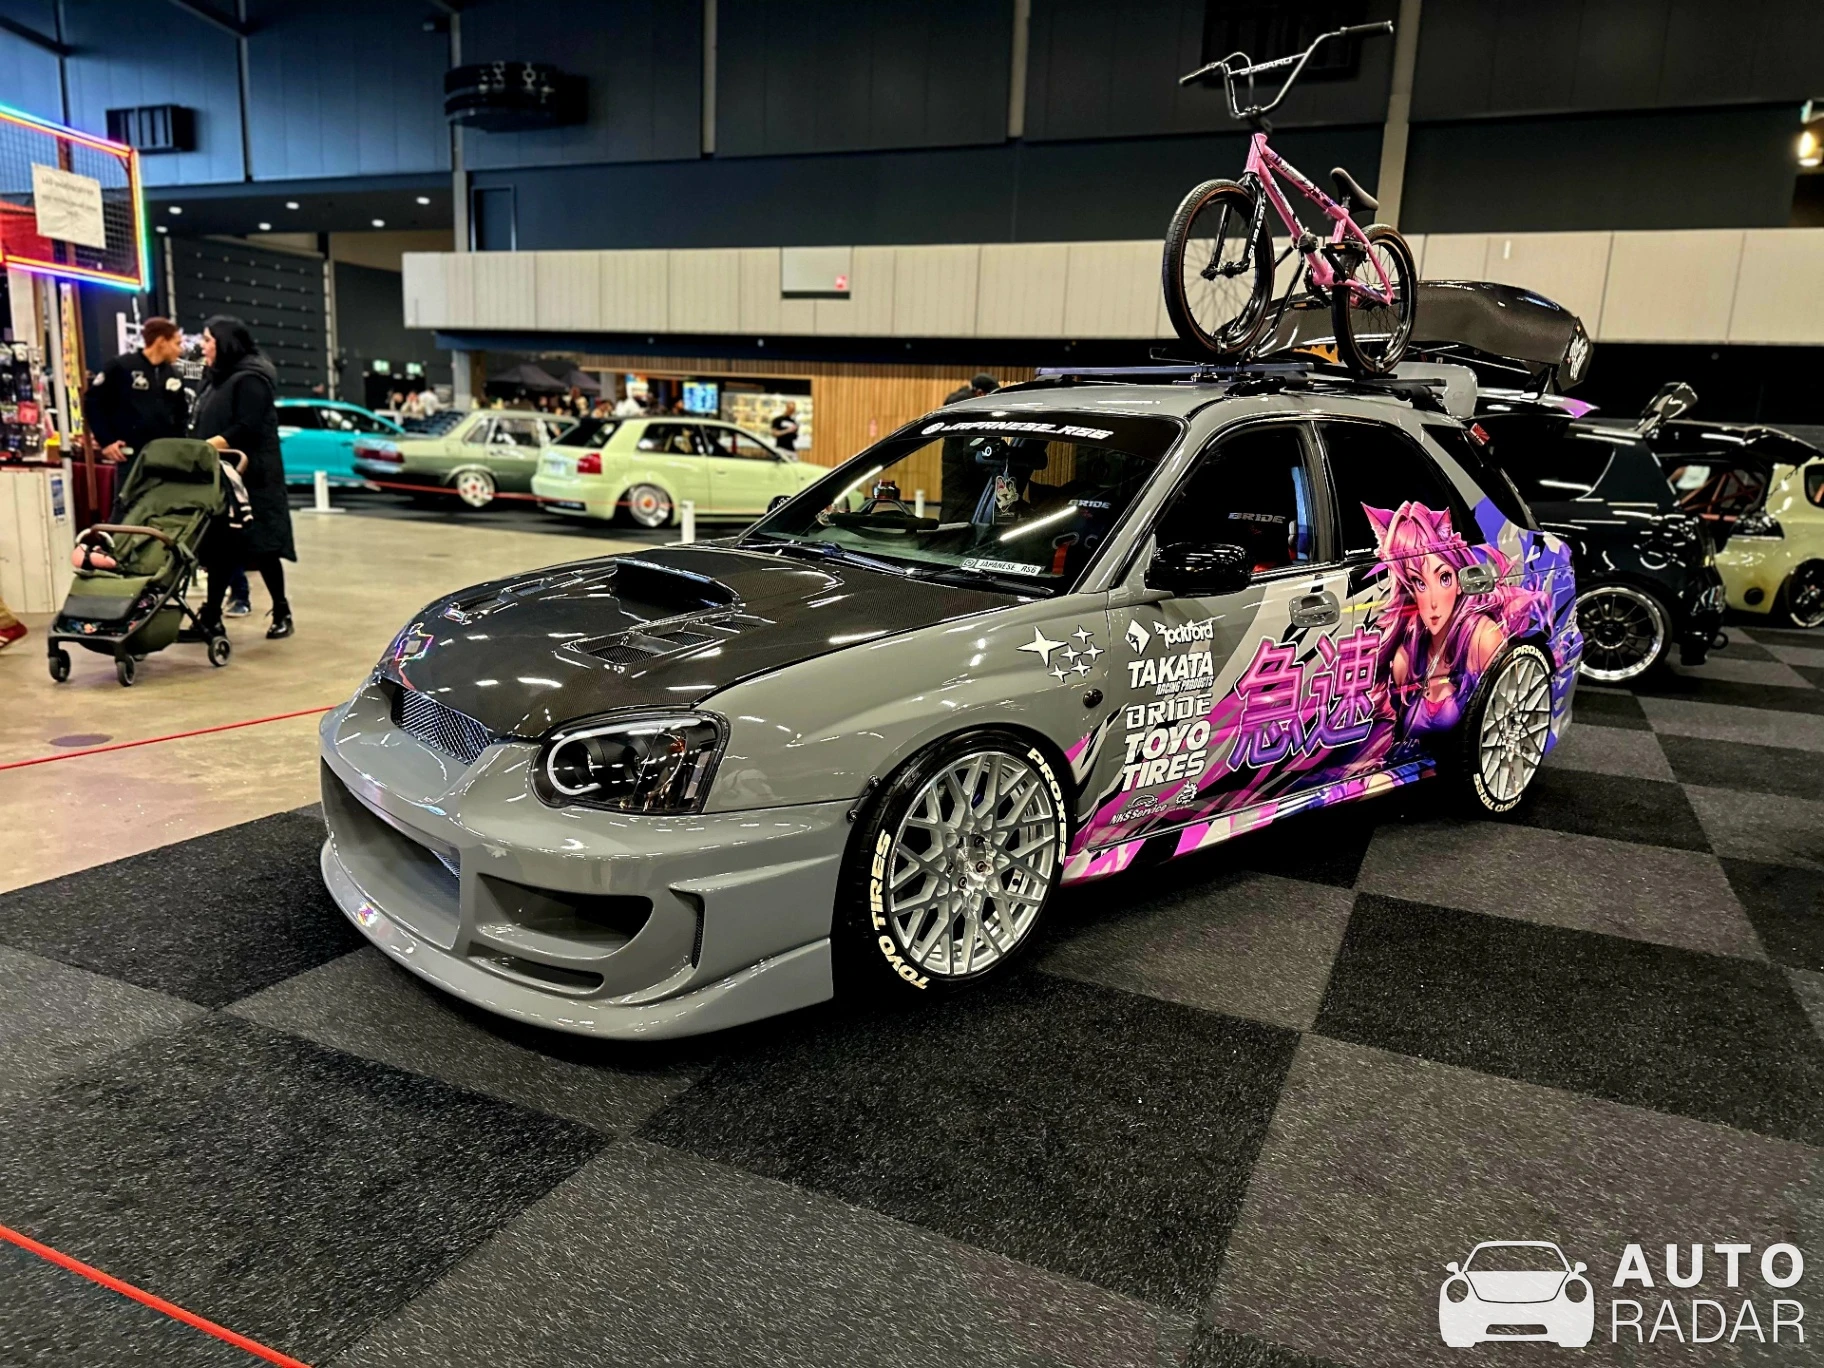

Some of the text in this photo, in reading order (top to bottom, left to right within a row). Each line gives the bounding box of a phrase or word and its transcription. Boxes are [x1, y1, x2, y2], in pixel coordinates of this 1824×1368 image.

[1228, 512, 1286, 524] BRIDE
[1127, 651, 1214, 689] TAKATA
[1155, 676, 1214, 696] RACING PRODUCTS
[1125, 693, 1213, 730] BRIDE
[1226, 625, 1380, 772] 急速
[1124, 719, 1211, 765] TOYO
[1121, 749, 1208, 792] TIRES
[1027, 747, 1067, 865] PROXES
[869, 828, 932, 991] TOYO TIRES
